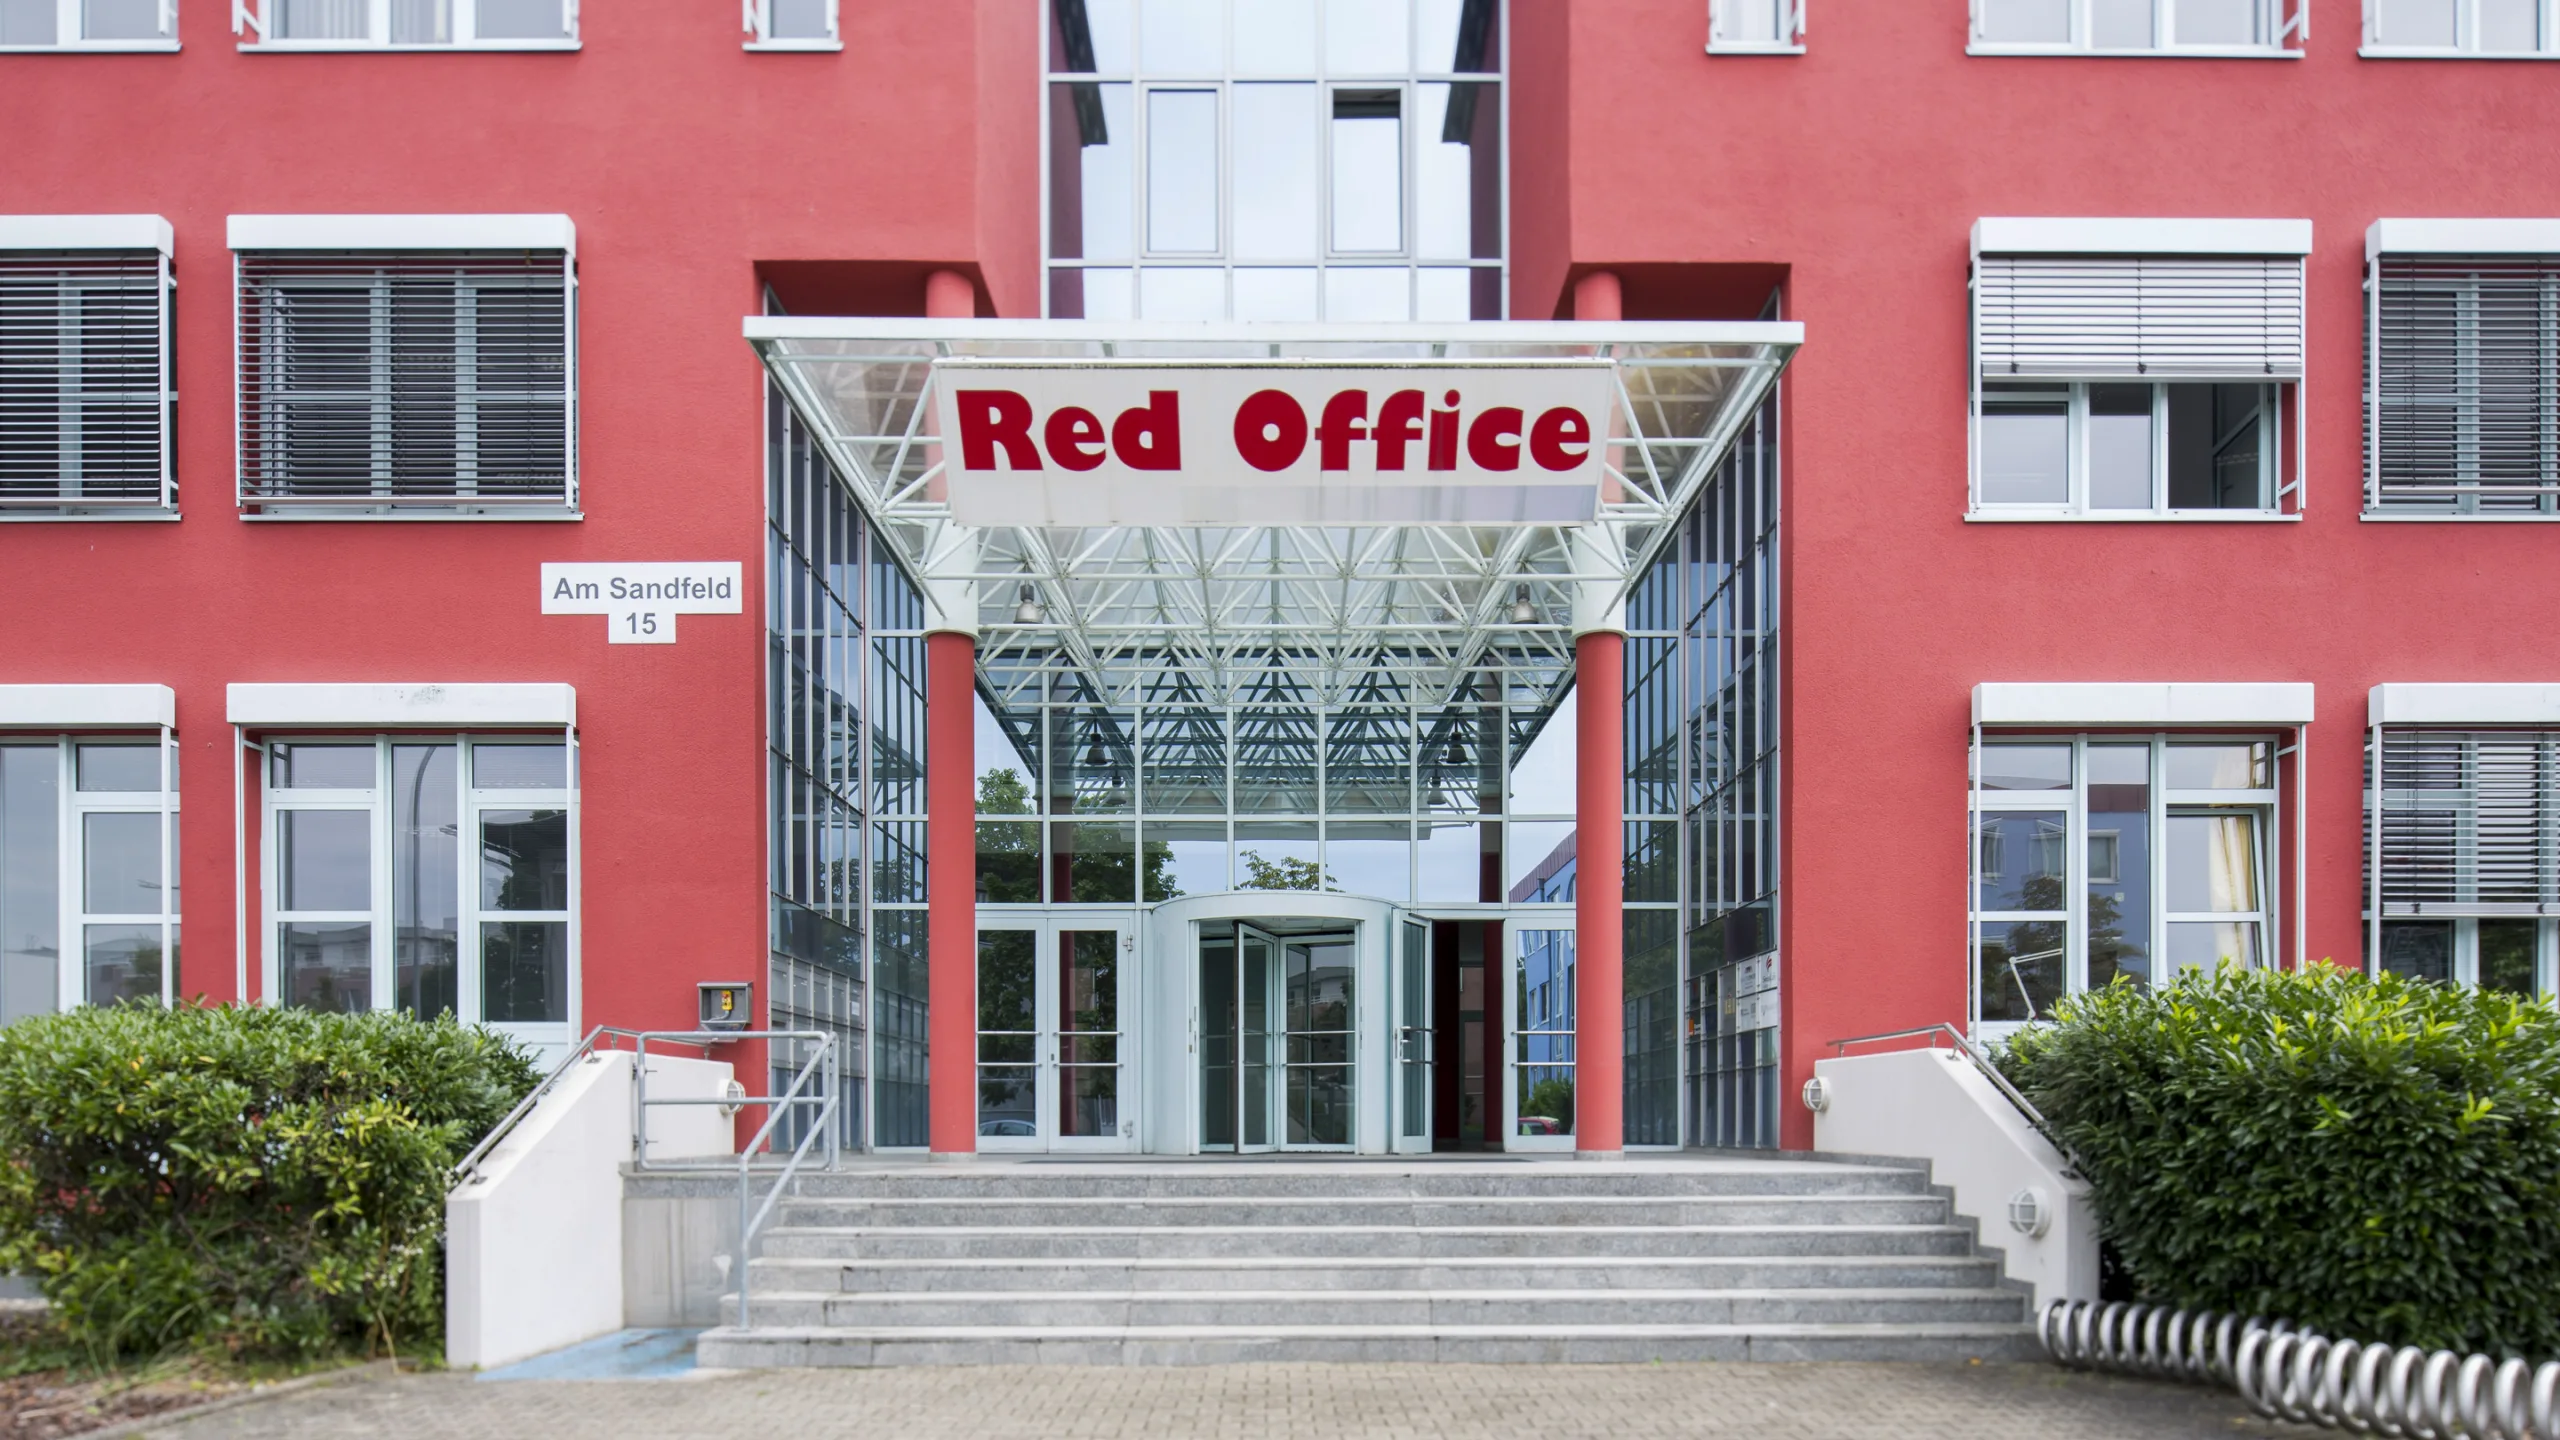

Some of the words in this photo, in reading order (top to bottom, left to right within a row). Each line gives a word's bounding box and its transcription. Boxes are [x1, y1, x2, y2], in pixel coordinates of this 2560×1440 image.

[957, 390, 1181, 472] Red
[1234, 389, 1591, 473] Office
[553, 577, 599, 600] Am
[609, 576, 732, 600] Sandfeld
[626, 612, 657, 635] 15
